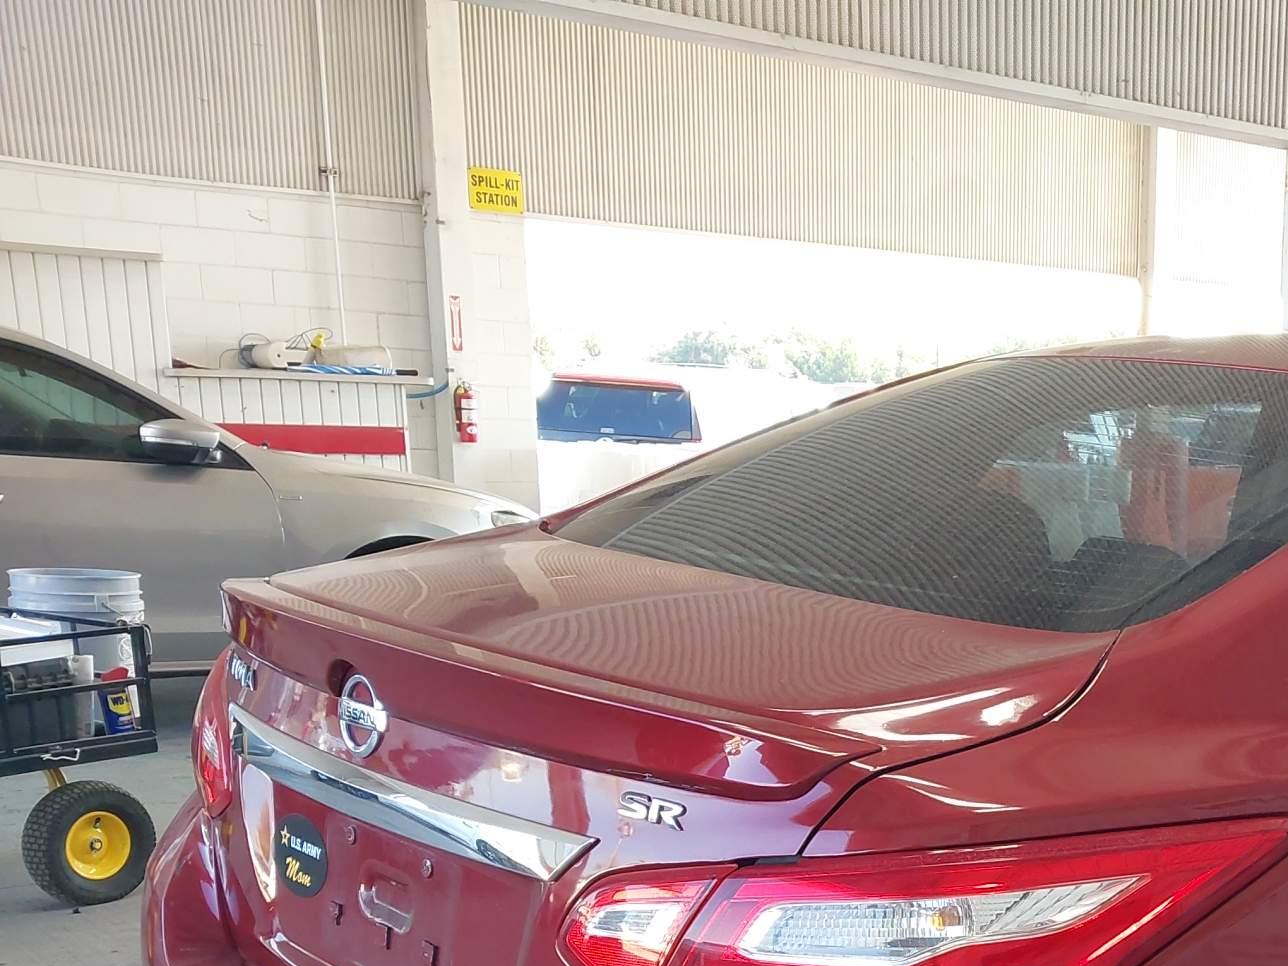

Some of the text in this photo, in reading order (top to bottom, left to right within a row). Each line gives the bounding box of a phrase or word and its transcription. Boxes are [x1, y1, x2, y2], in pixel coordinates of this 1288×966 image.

[471, 174, 520, 192] SPILL-KIT
[475, 191, 518, 208] STATION
[617, 791, 687, 831] SR
[289, 835, 322, 860] U.S. ARMY
[285, 856, 311, 887] Mom
